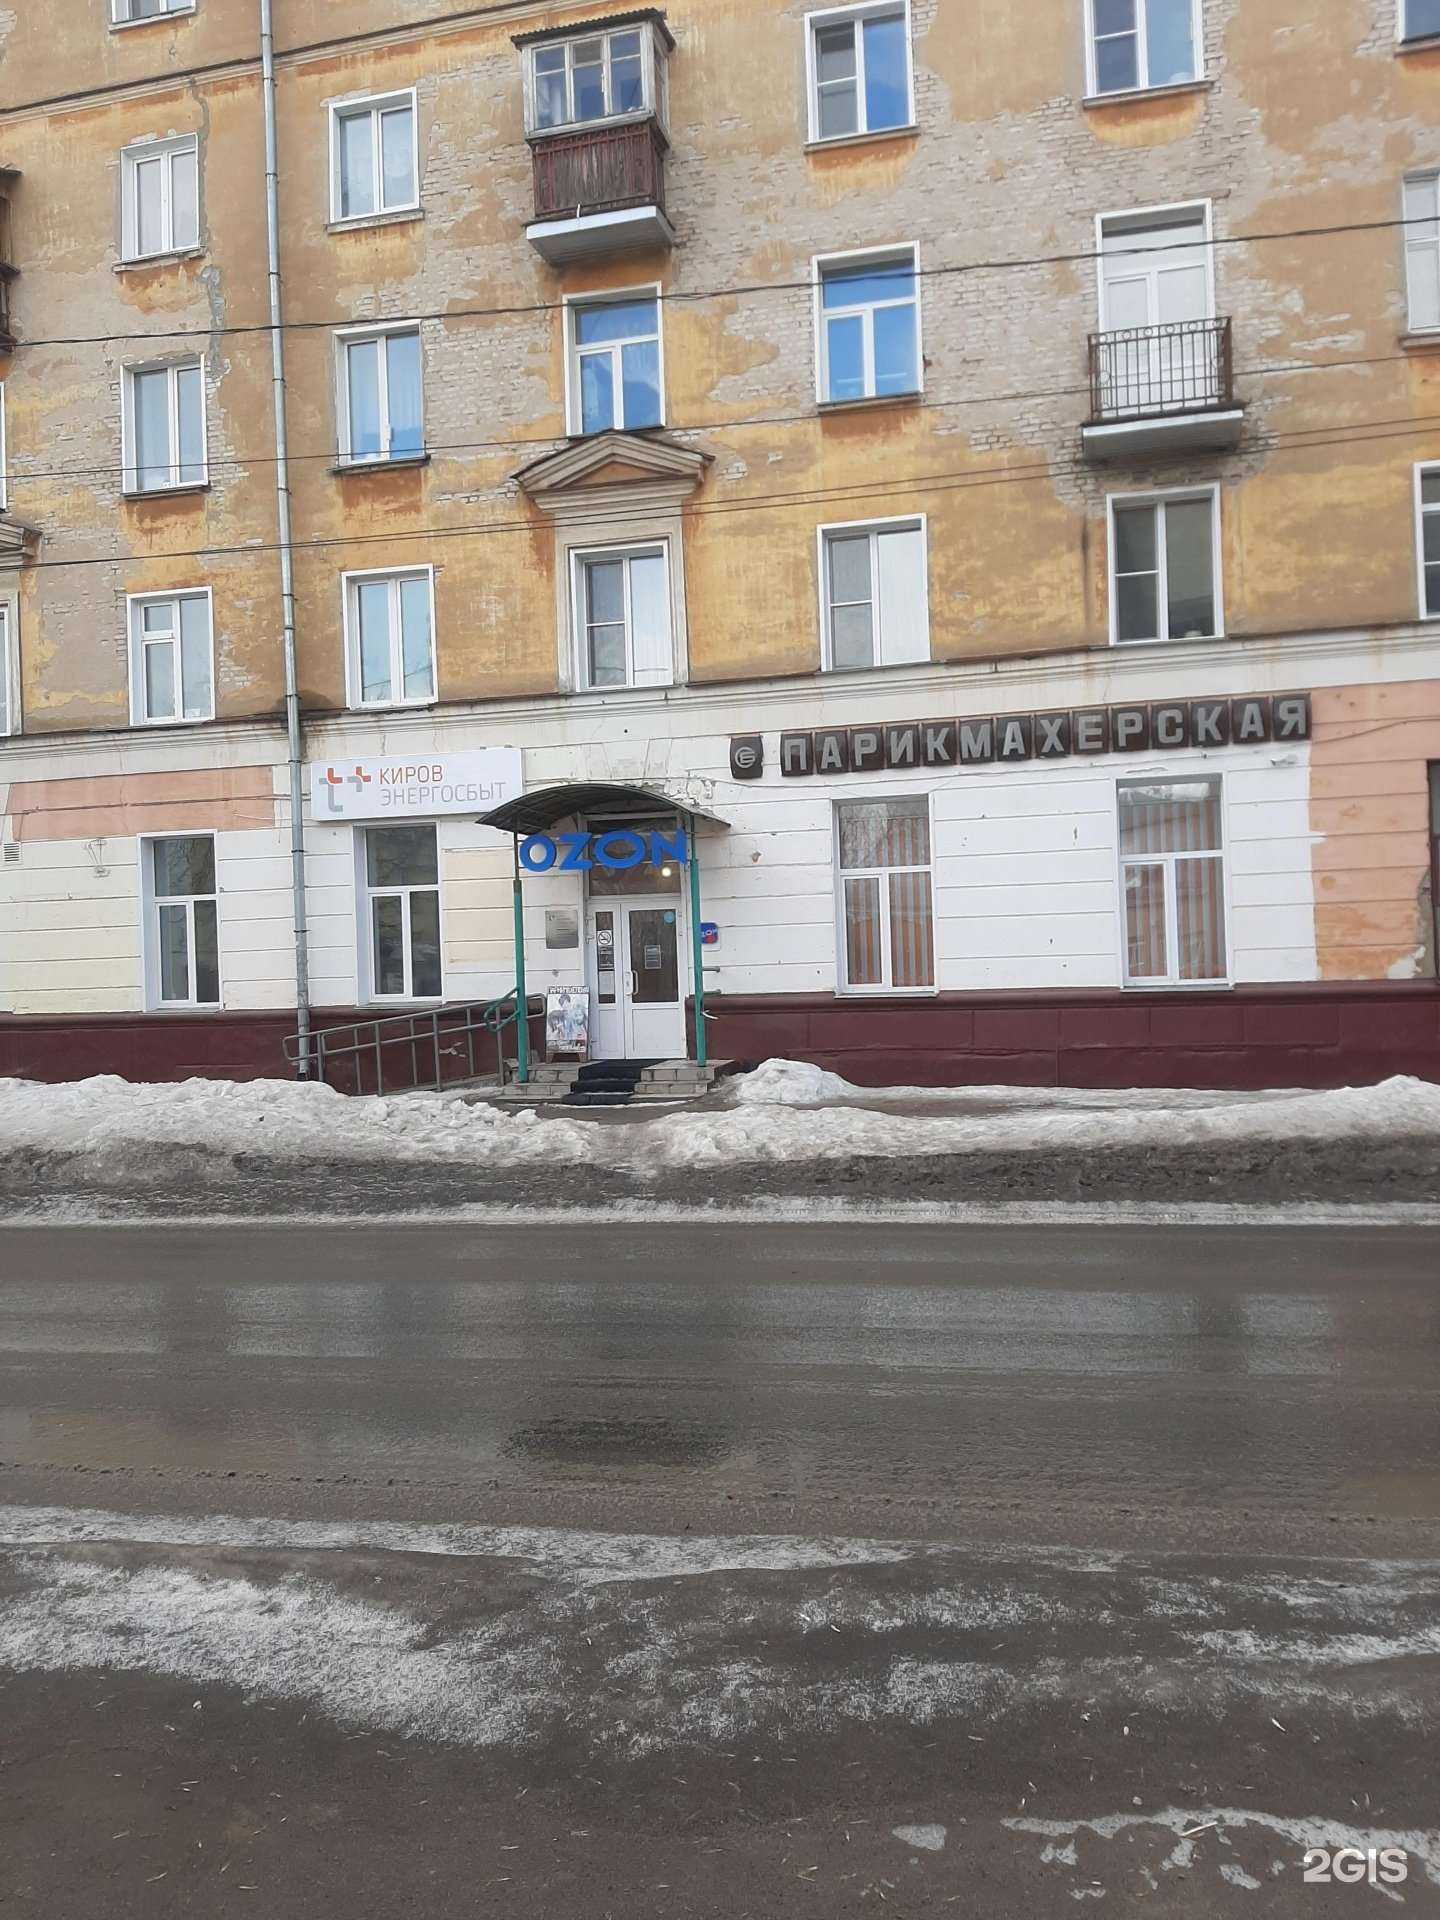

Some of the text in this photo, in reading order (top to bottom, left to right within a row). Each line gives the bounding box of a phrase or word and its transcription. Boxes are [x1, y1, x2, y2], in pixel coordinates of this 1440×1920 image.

[783, 703, 1307, 772] ПАРИКМАХЕРСКАЯ
[379, 764, 444, 785] КИРОВ
[380, 781, 507, 807] ЭНЕРГОСБЫТ
[519, 828, 689, 873] OZON
